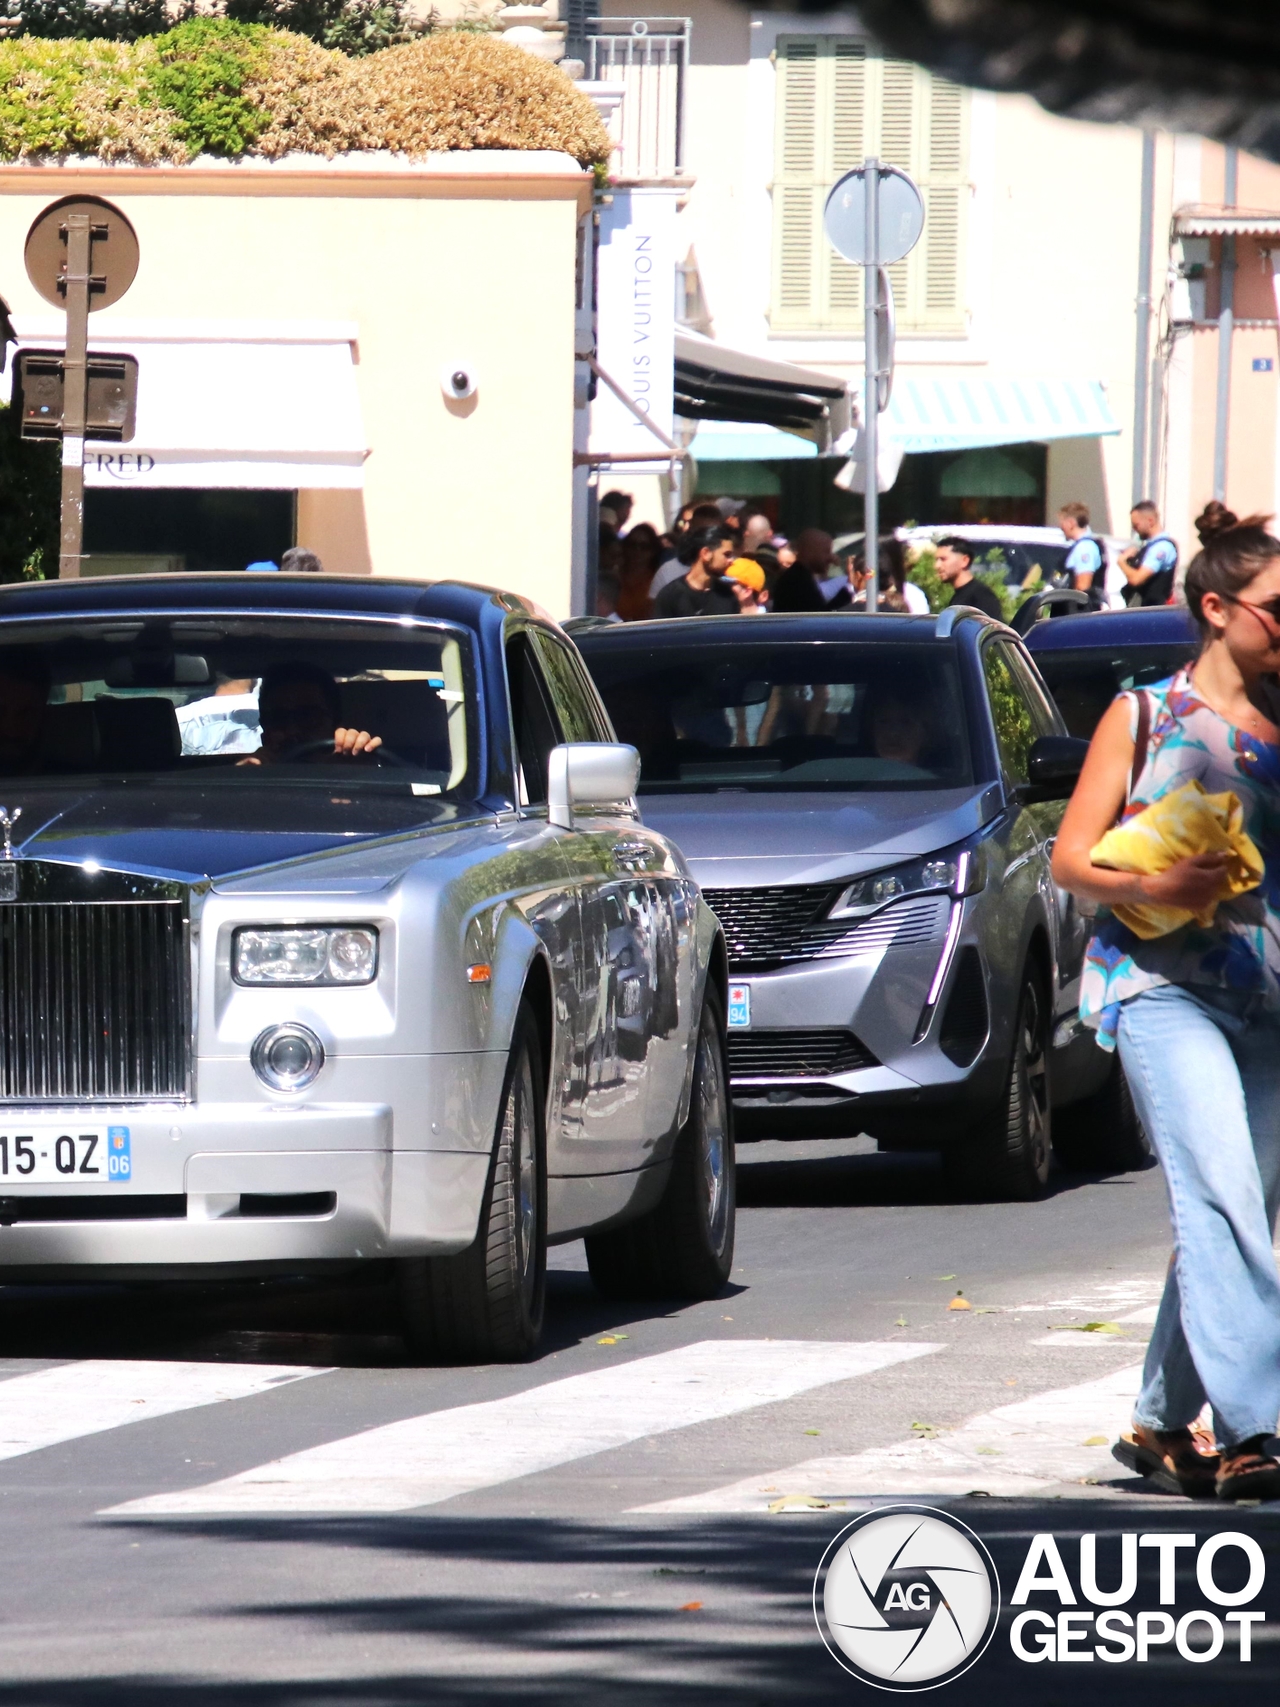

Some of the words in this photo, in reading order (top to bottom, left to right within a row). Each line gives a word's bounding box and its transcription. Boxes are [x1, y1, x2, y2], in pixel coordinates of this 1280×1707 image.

[633, 235, 652, 344] VUITTON
[730, 1007, 745, 1022] 94
[109, 1155, 130, 1175] 06
